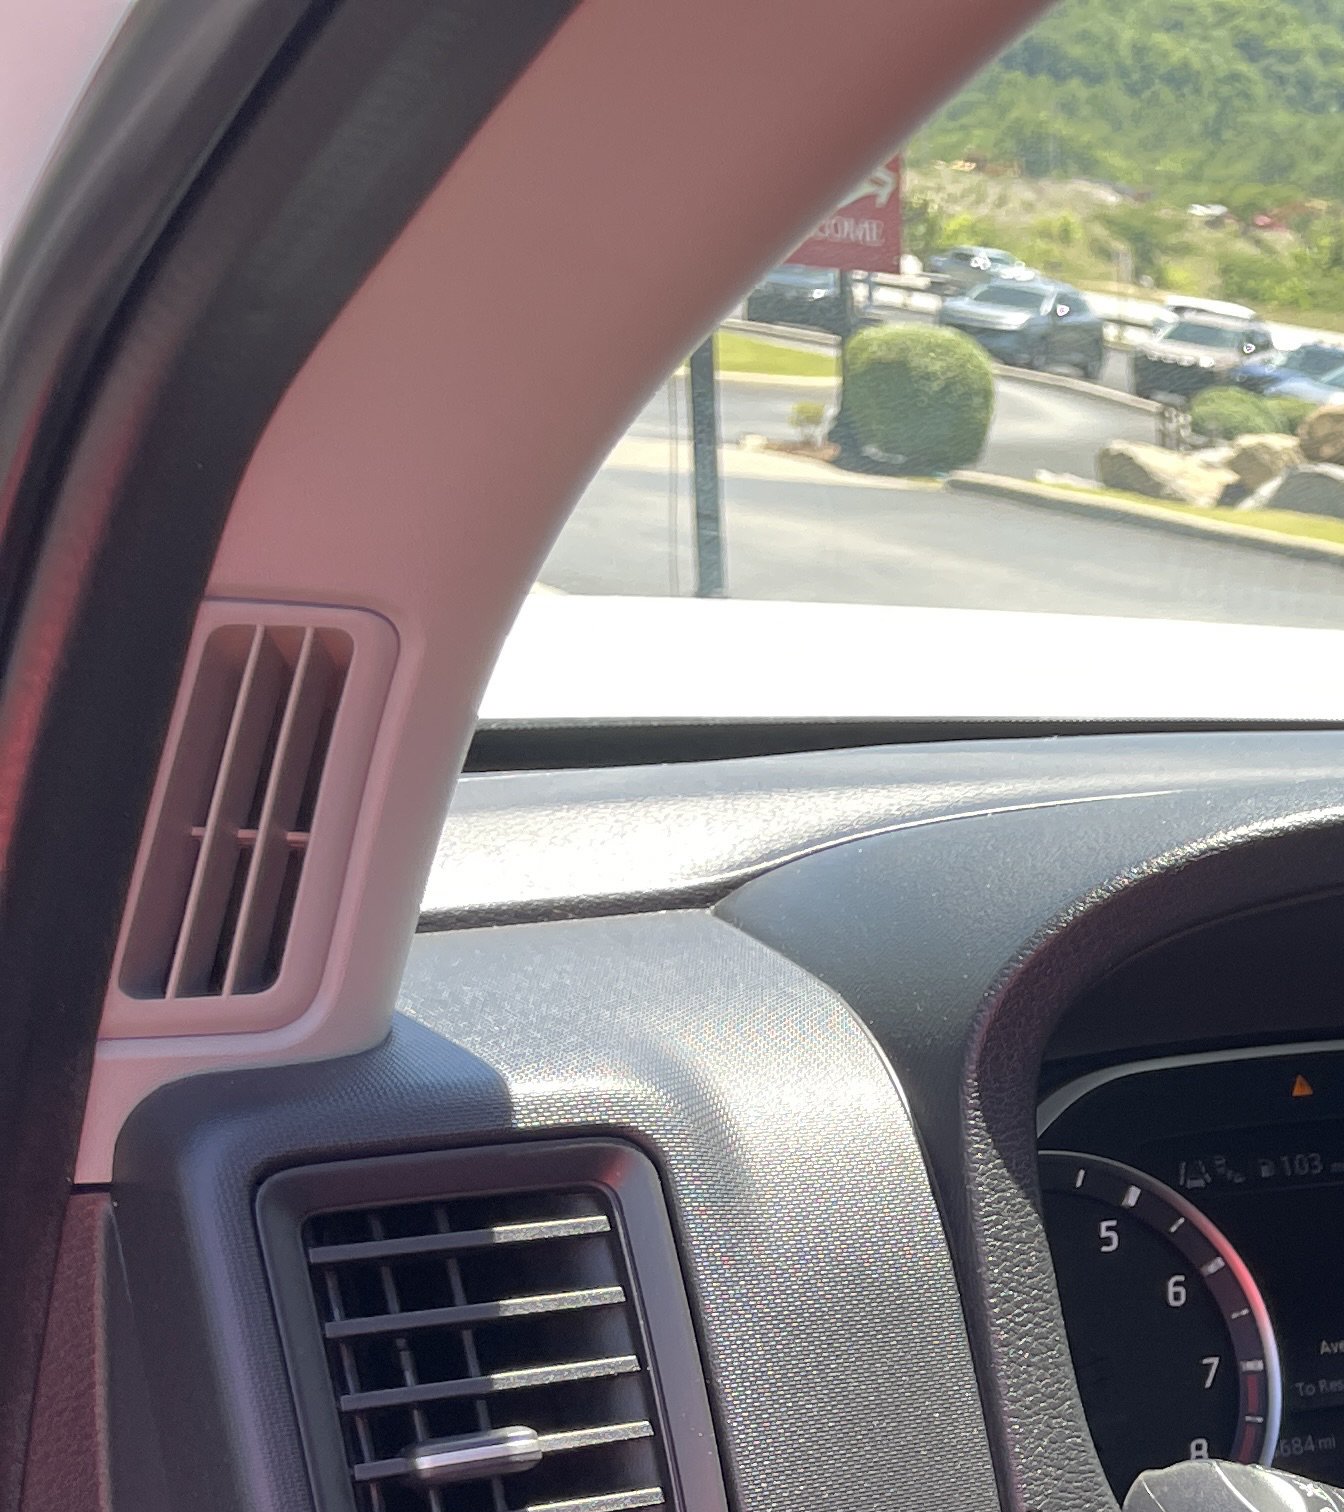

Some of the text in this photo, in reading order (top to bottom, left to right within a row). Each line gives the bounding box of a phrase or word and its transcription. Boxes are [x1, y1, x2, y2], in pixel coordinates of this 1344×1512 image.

[1100, 1220, 1119, 1252] 5
[1167, 1275, 1186, 1307] 6
[1201, 1356, 1220, 1389] 7
[1295, 1381, 1316, 1397] To
